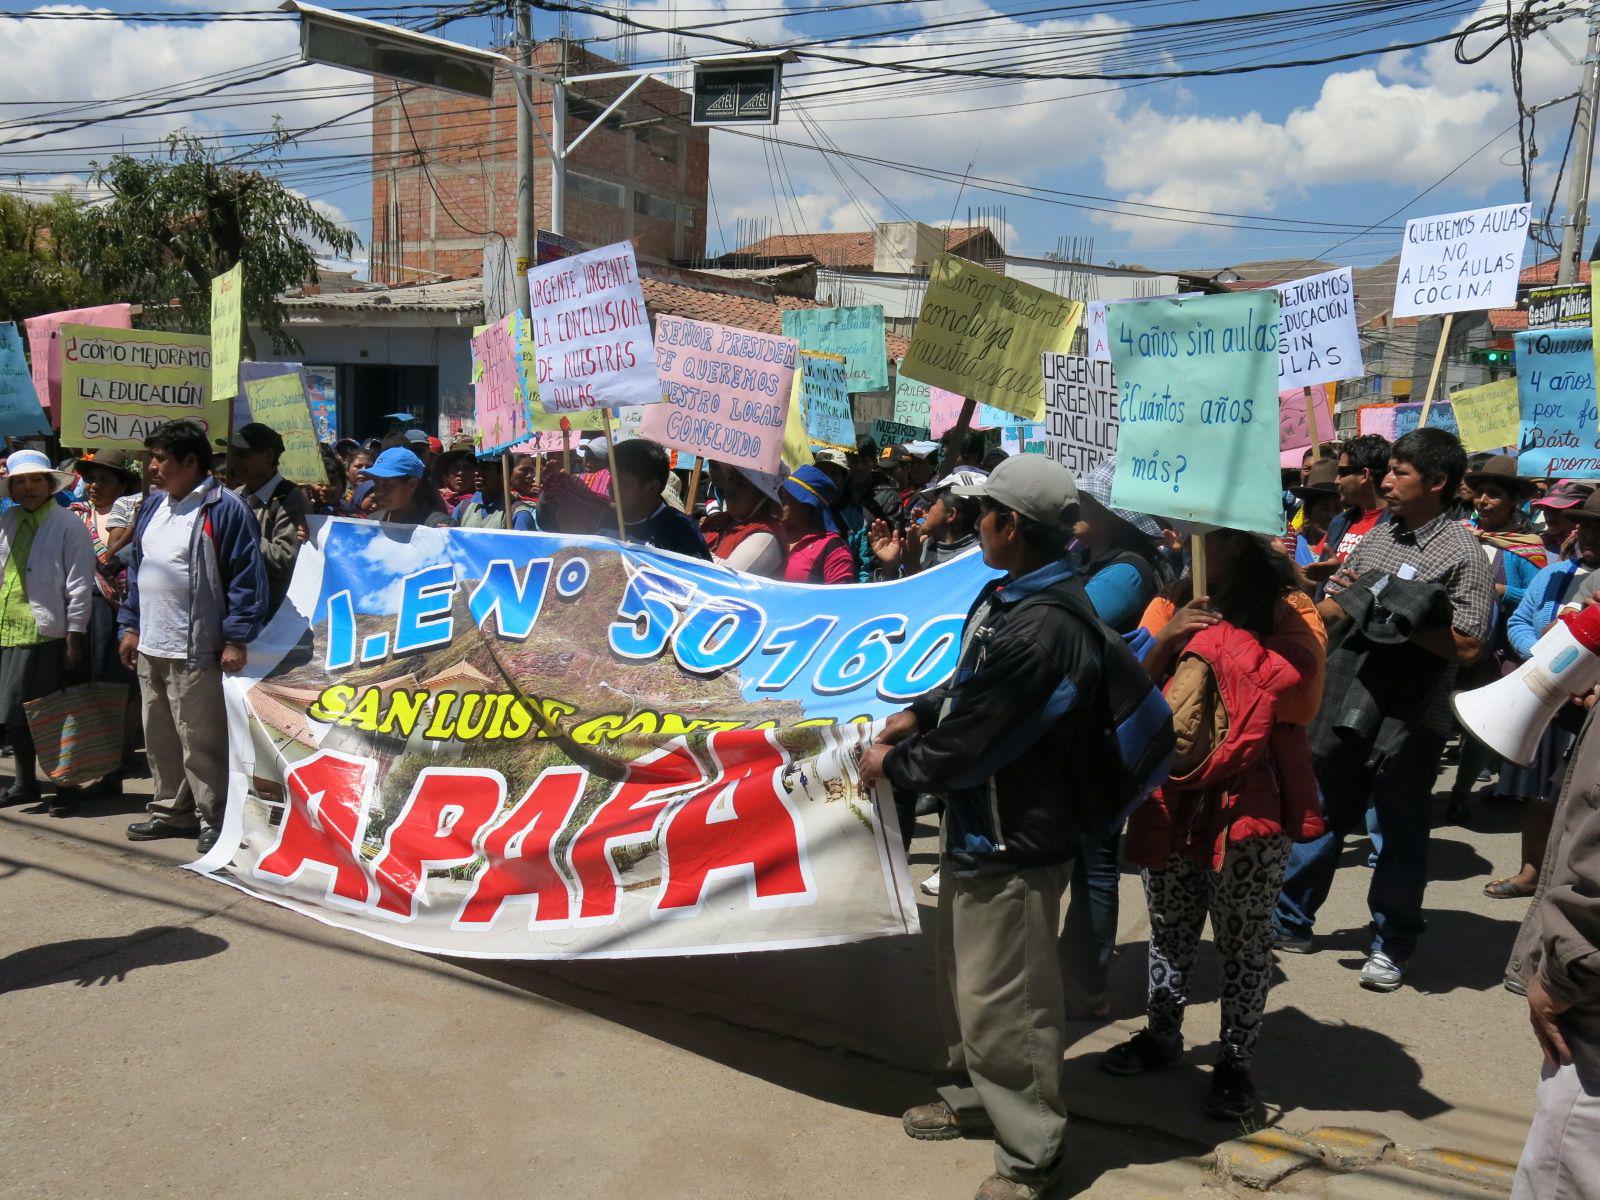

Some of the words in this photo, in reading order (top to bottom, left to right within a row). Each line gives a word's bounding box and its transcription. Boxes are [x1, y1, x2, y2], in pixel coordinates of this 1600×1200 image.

[1409, 215, 1475, 244] QUEREMOS
[1480, 206, 1528, 233] AULAS
[1401, 267, 1410, 284] A
[1419, 264, 1447, 284] LAS
[1458, 252, 1514, 278] AULAS
[1442, 242, 1467, 263] NO
[530, 271, 582, 308] URGENTE,
[583, 255, 633, 294] URGENTE
[1414, 280, 1492, 305] COCINA
[534, 318, 551, 347] LA
[557, 296, 641, 342] CONCLUSION
[1559, 293, 1590, 318] Pública
[658, 319, 714, 352] SEÑOR
[717, 330, 796, 367] PRESIDEN
[921, 301, 1015, 361] concluya
[1120, 322, 1133, 357] 4
[1138, 325, 1178, 358] años
[1186, 321, 1216, 357] sin
[1222, 308, 1279, 353] aulas
[1279, 332, 1313, 354] SIN
[66, 337, 126, 361] ¿CÓMO
[132, 346, 211, 370] MEJORAMO
[538, 357, 554, 383] DE
[564, 341, 636, 379] NUESTRAS
[656, 347, 676, 372] TE
[683, 357, 779, 397] QUEREMOS
[911, 338, 979, 377] nuestra
[1043, 353, 1118, 389] URGENTE
[80, 379, 103, 399] LA
[109, 381, 203, 405] EDUCACIÓN
[554, 384, 596, 410] AULAS
[1530, 370, 1541, 392] 4
[1550, 371, 1596, 391] años
[730, 397, 783, 427] LOCAL
[1044, 382, 1119, 421] URGENTE
[1120, 381, 1185, 423] ¿Cuántos
[1201, 397, 1254, 425] años
[1533, 402, 1565, 425] por
[87, 414, 117, 435] SIN
[667, 411, 762, 458] CONCLUIDO
[1132, 450, 1187, 493] más?
[608, 567, 967, 699] 50160
[309, 685, 428, 737] SAN
[425, 692, 532, 740] LUIS
[253, 727, 818, 931] APAFA
